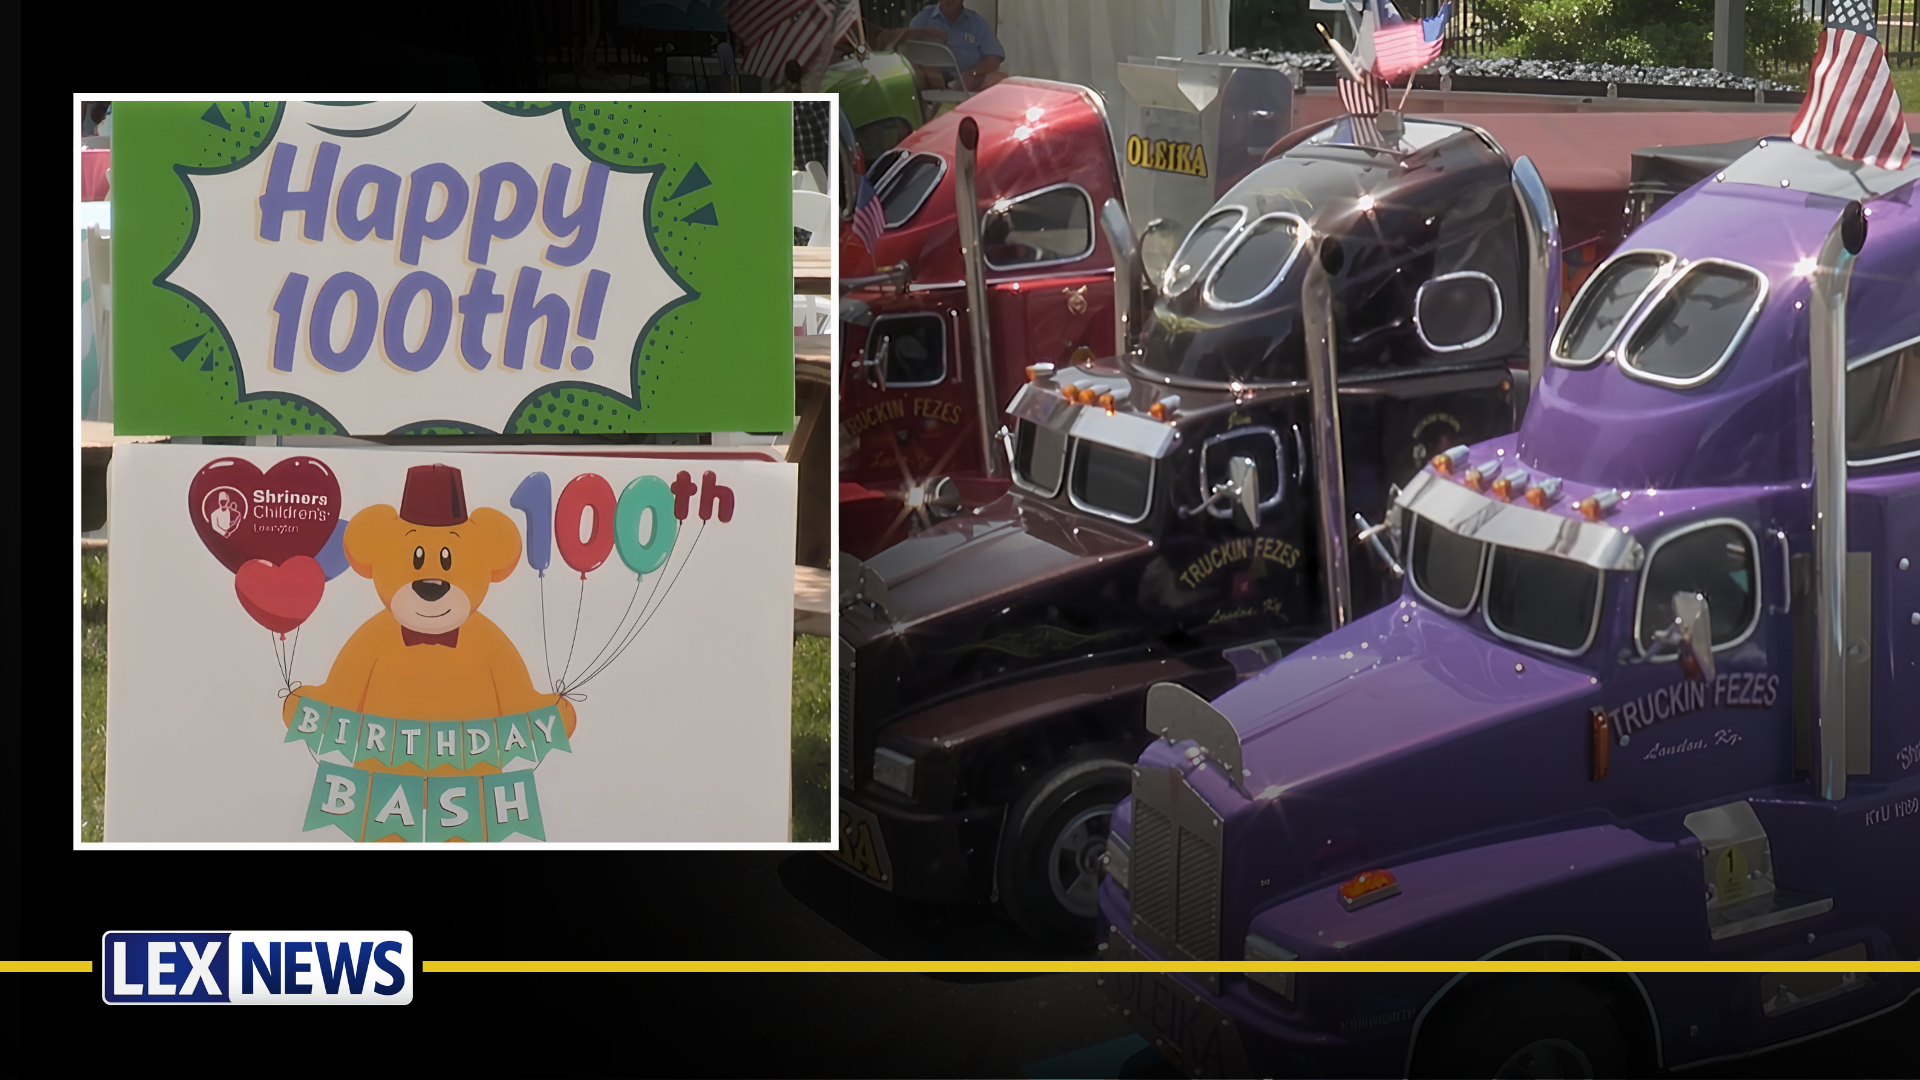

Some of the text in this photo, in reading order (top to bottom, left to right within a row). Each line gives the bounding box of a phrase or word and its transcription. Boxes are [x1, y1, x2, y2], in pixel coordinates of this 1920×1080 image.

[1126, 134, 1208, 178] OLEIKA
[257, 141, 611, 267] Happy
[270, 266, 611, 373] 100th!
[913, 397, 962, 425] FEZES
[510, 470, 735, 582] 100th
[1254, 536, 1301, 569] FEZES
[1714, 672, 1779, 706] FEZES
[297, 706, 556, 756] BIRTHDAY
[320, 774, 530, 828] BASH
[1726, 848, 1734, 873] 1
